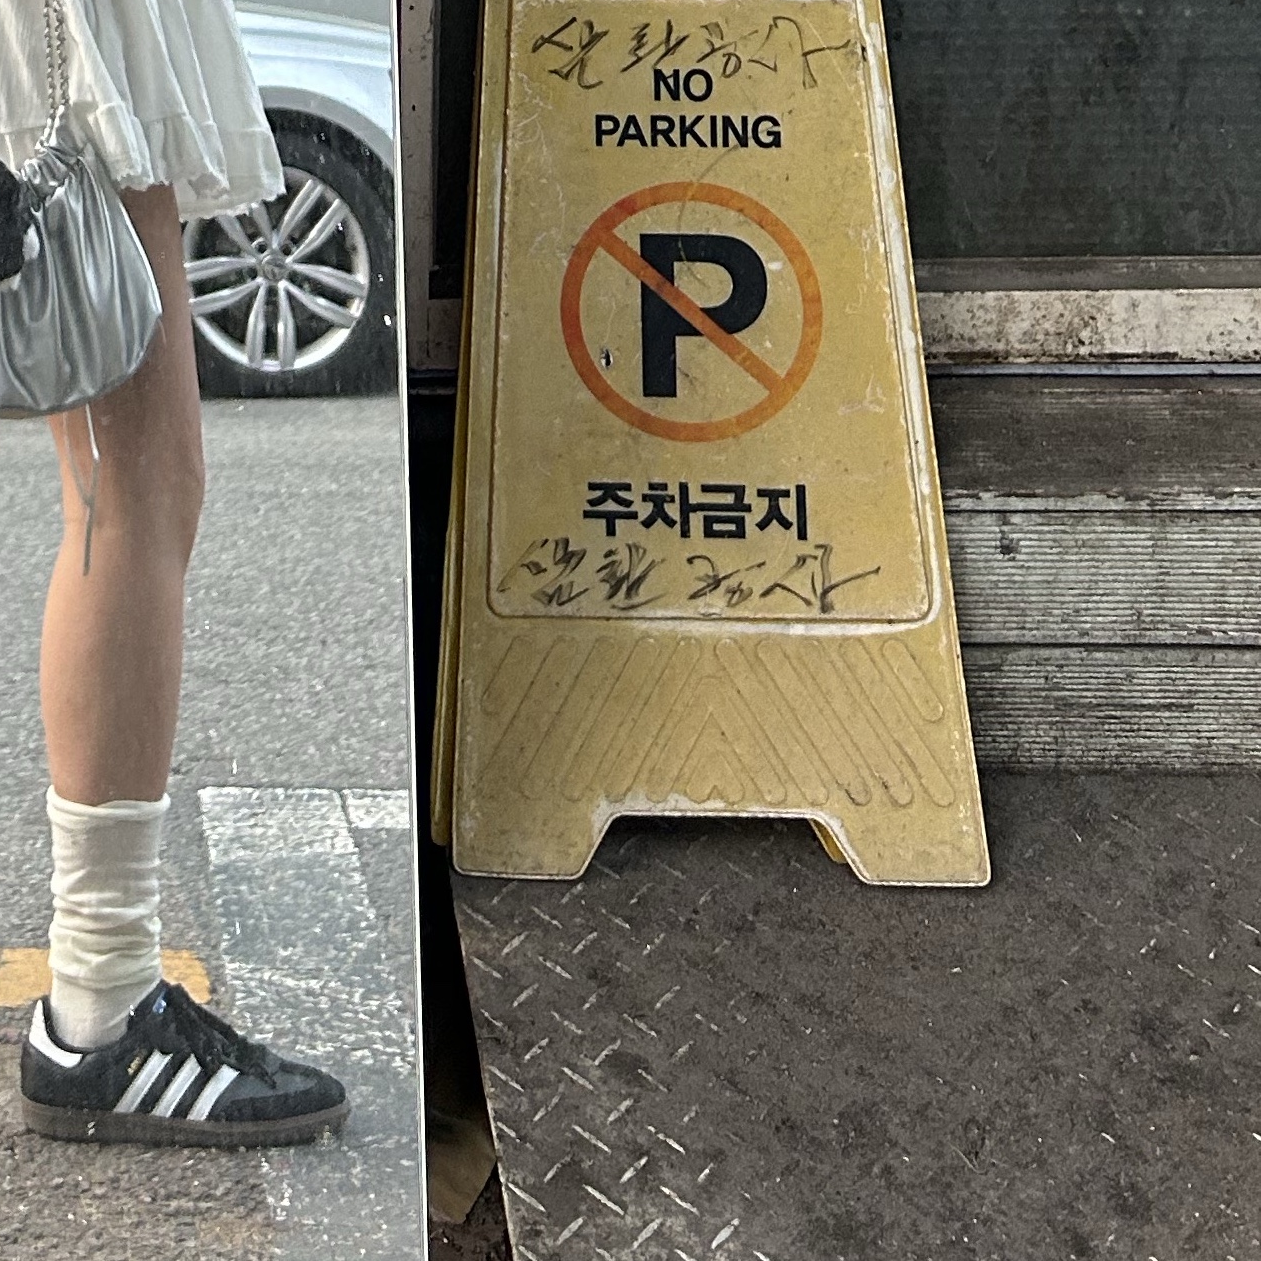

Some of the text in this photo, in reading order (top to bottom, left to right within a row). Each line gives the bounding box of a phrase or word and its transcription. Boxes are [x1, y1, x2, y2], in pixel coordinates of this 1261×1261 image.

[653, 68, 714, 103] NO
[594, 113, 783, 149] PARKING
[638, 231, 770, 399] P
[582, 479, 808, 541] 주차금지
